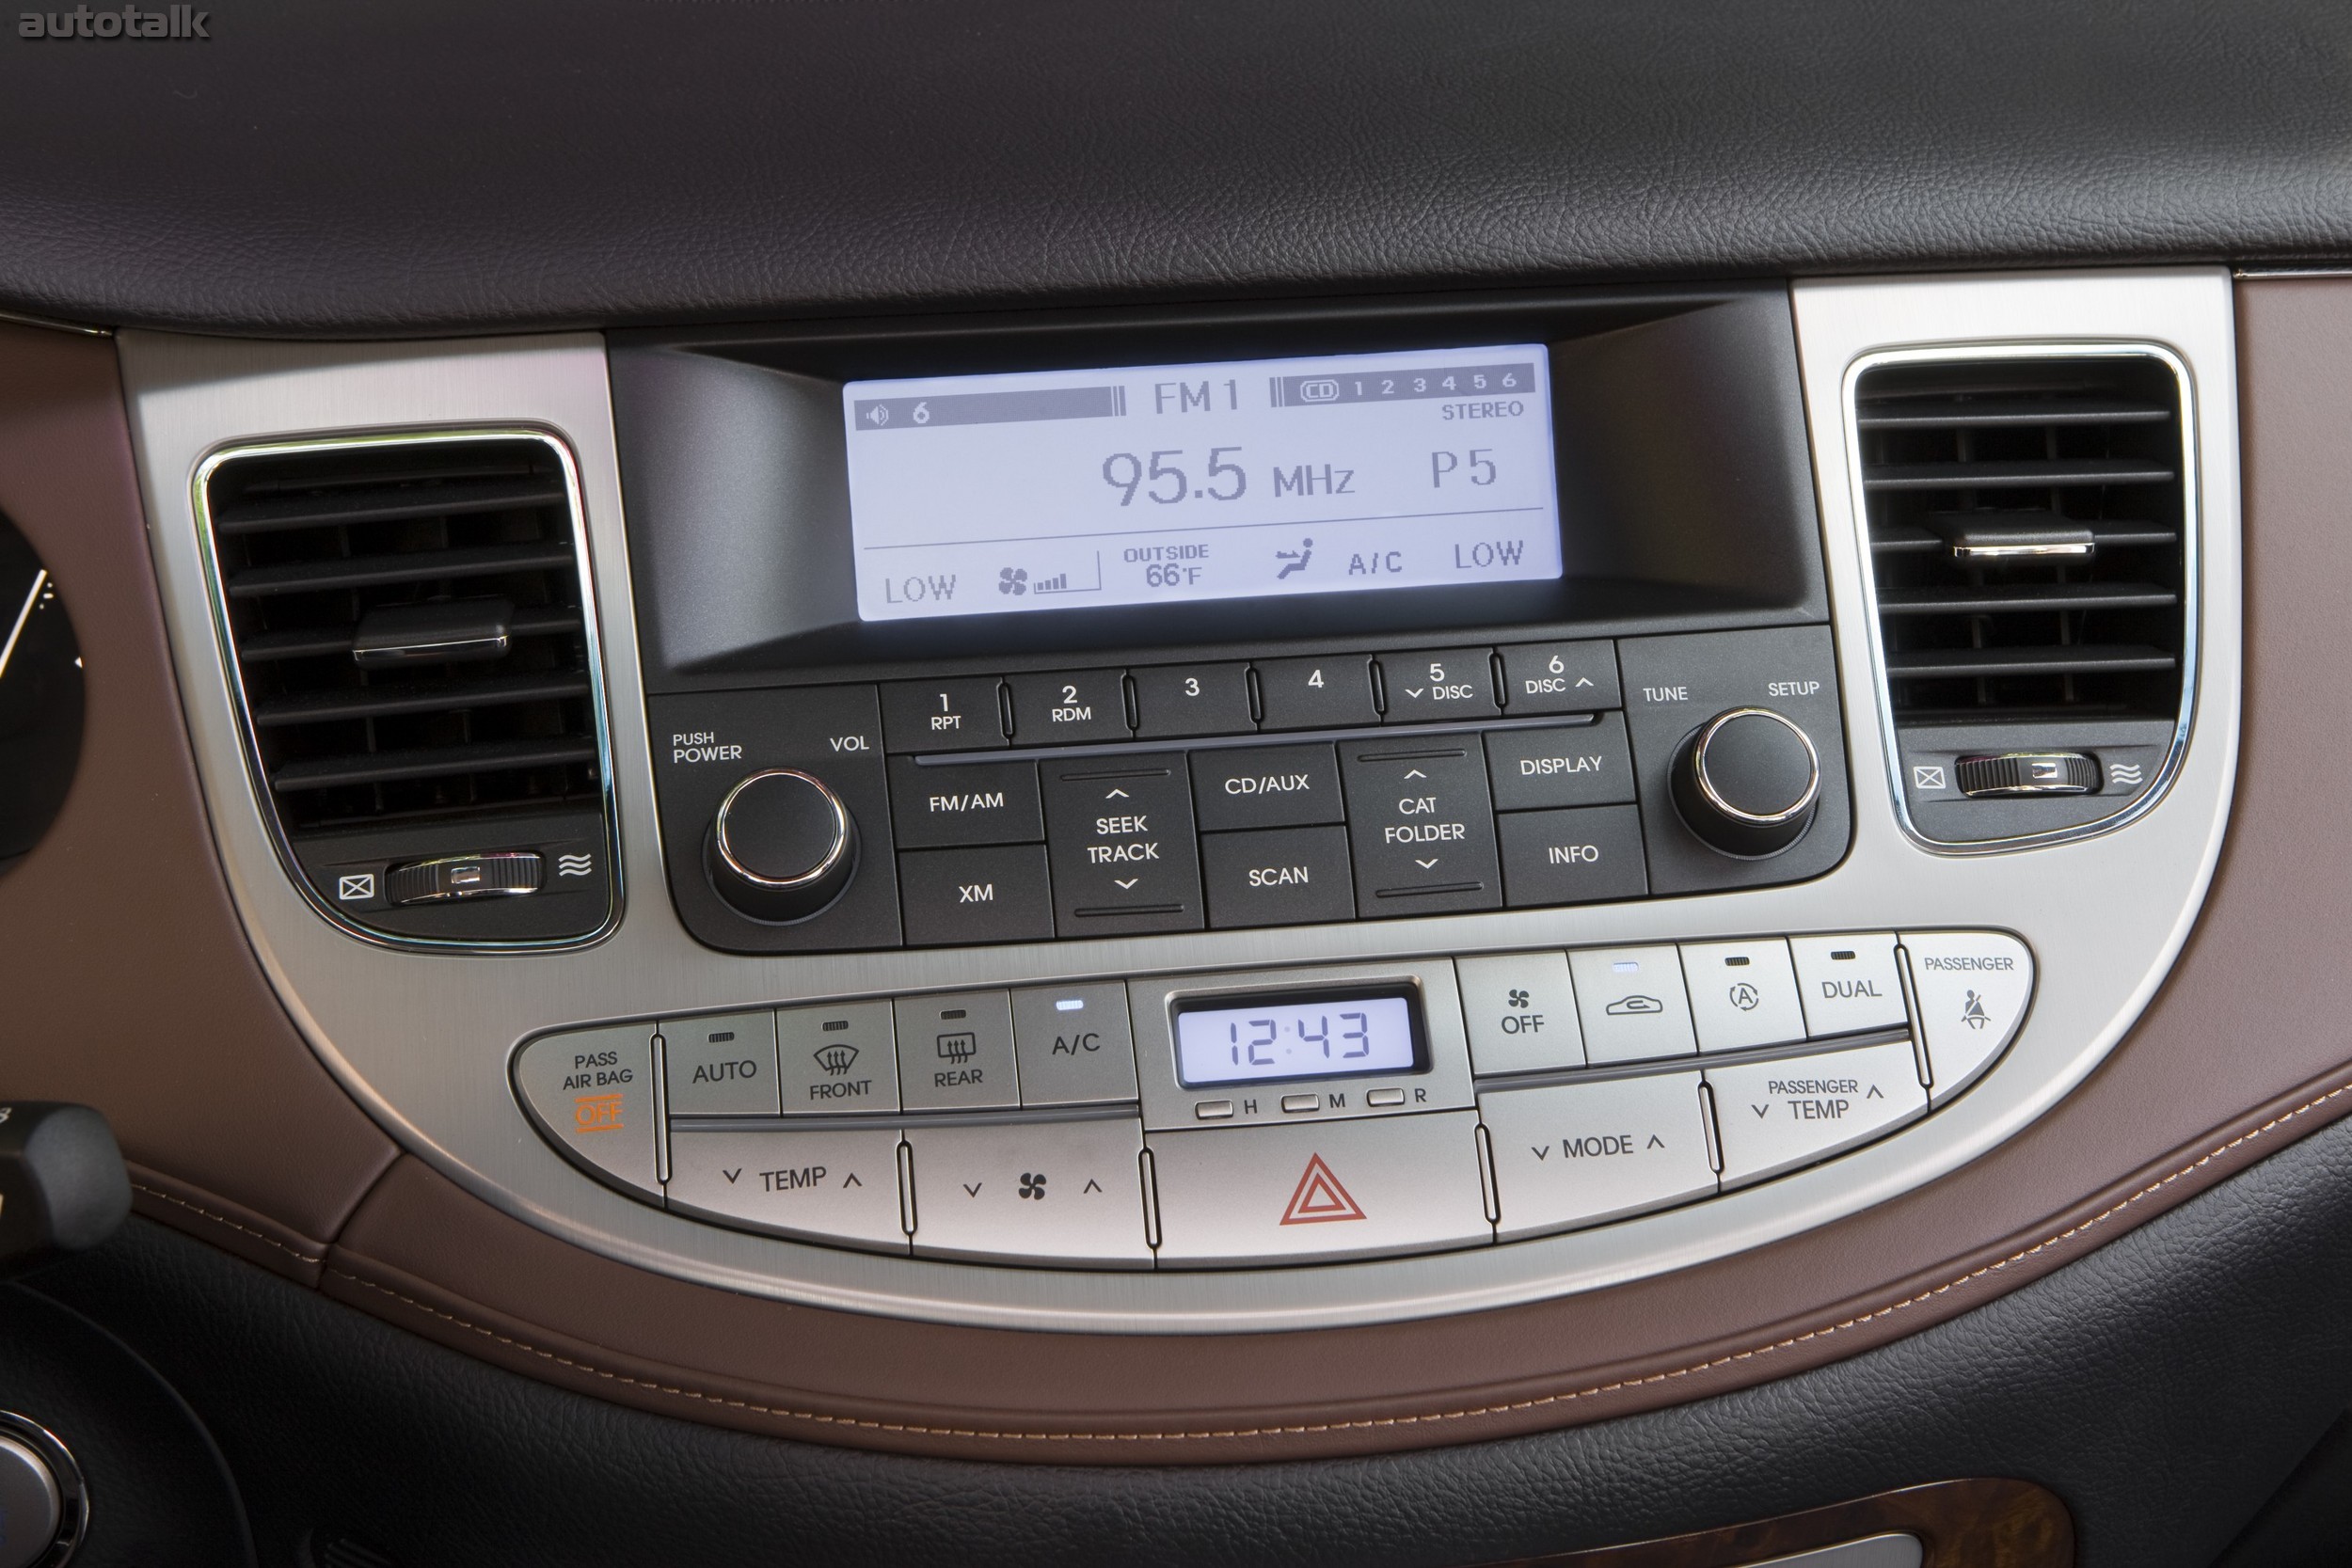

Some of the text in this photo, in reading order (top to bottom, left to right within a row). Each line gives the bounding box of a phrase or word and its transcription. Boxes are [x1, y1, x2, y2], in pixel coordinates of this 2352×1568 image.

[1354, 381, 1362, 396] 1
[1381, 379, 1394, 394] 2
[1413, 377, 1427, 392] 3
[1441, 375, 1457, 390] 4
[1473, 374, 1487, 389] 5
[1502, 372, 1518, 388] 6
[913, 402, 931, 425] 6
[1441, 400, 1525, 421] STEREO
[1102, 446, 1356, 507] 95.5 MHz
[1123, 544, 1210, 564] OUTSIDE
[1348, 550, 1403, 576] A/C
[1454, 540, 1524, 569] LOW
[885, 574, 957, 604] LOW
[1429, 663, 1445, 682] 5
[1549, 655, 1565, 674] 6
[1184, 677, 1200, 697] 3
[1308, 669, 1325, 689] 4
[1525, 677, 1566, 694] DISC
[1768, 681, 1820, 697] SETUP
[1062, 685, 1078, 705] 2
[1432, 684, 1473, 700] DISC
[1643, 686, 1689, 702] TUNE
[939, 693, 948, 712] 1
[930, 715, 961, 731] RPT
[1052, 706, 1091, 722] RDM
[674, 732, 714, 746] PUSH
[830, 736, 870, 752] VOL
[674, 746, 742, 764] POWER
[1519, 755, 1602, 775] DISPLAY
[1224, 774, 1310, 795] CD/AUX
[930, 792, 1004, 813] FM/AM
[1398, 797, 1437, 815] CAT
[1096, 815, 1149, 835] SEEK
[1384, 823, 1465, 844] FOLDER
[1087, 842, 1160, 863] TRACK
[1549, 845, 1599, 864] INFO
[1248, 866, 1309, 887] SCAN
[959, 883, 993, 903] XM
[1924, 957, 2014, 971] PASSENGER
[1821, 979, 1883, 999] DUAL
[1501, 1014, 1545, 1035] OFF
[1052, 1033, 1102, 1056] A/C
[574, 1051, 618, 1069] PASS
[691, 1059, 757, 1085] AUTO
[934, 1069, 983, 1087] REAR
[809, 1080, 872, 1101] FRONT
[1414, 1087, 1427, 1103] R
[1768, 1079, 1859, 1097] PASSENGER
[1244, 1099, 1258, 1115] H
[1328, 1093, 1346, 1109] M
[1787, 1099, 1850, 1120] TEMP
[575, 1101, 624, 1127] OFF
[1562, 1134, 1634, 1159] MODE
[758, 1165, 827, 1192] TEMP
